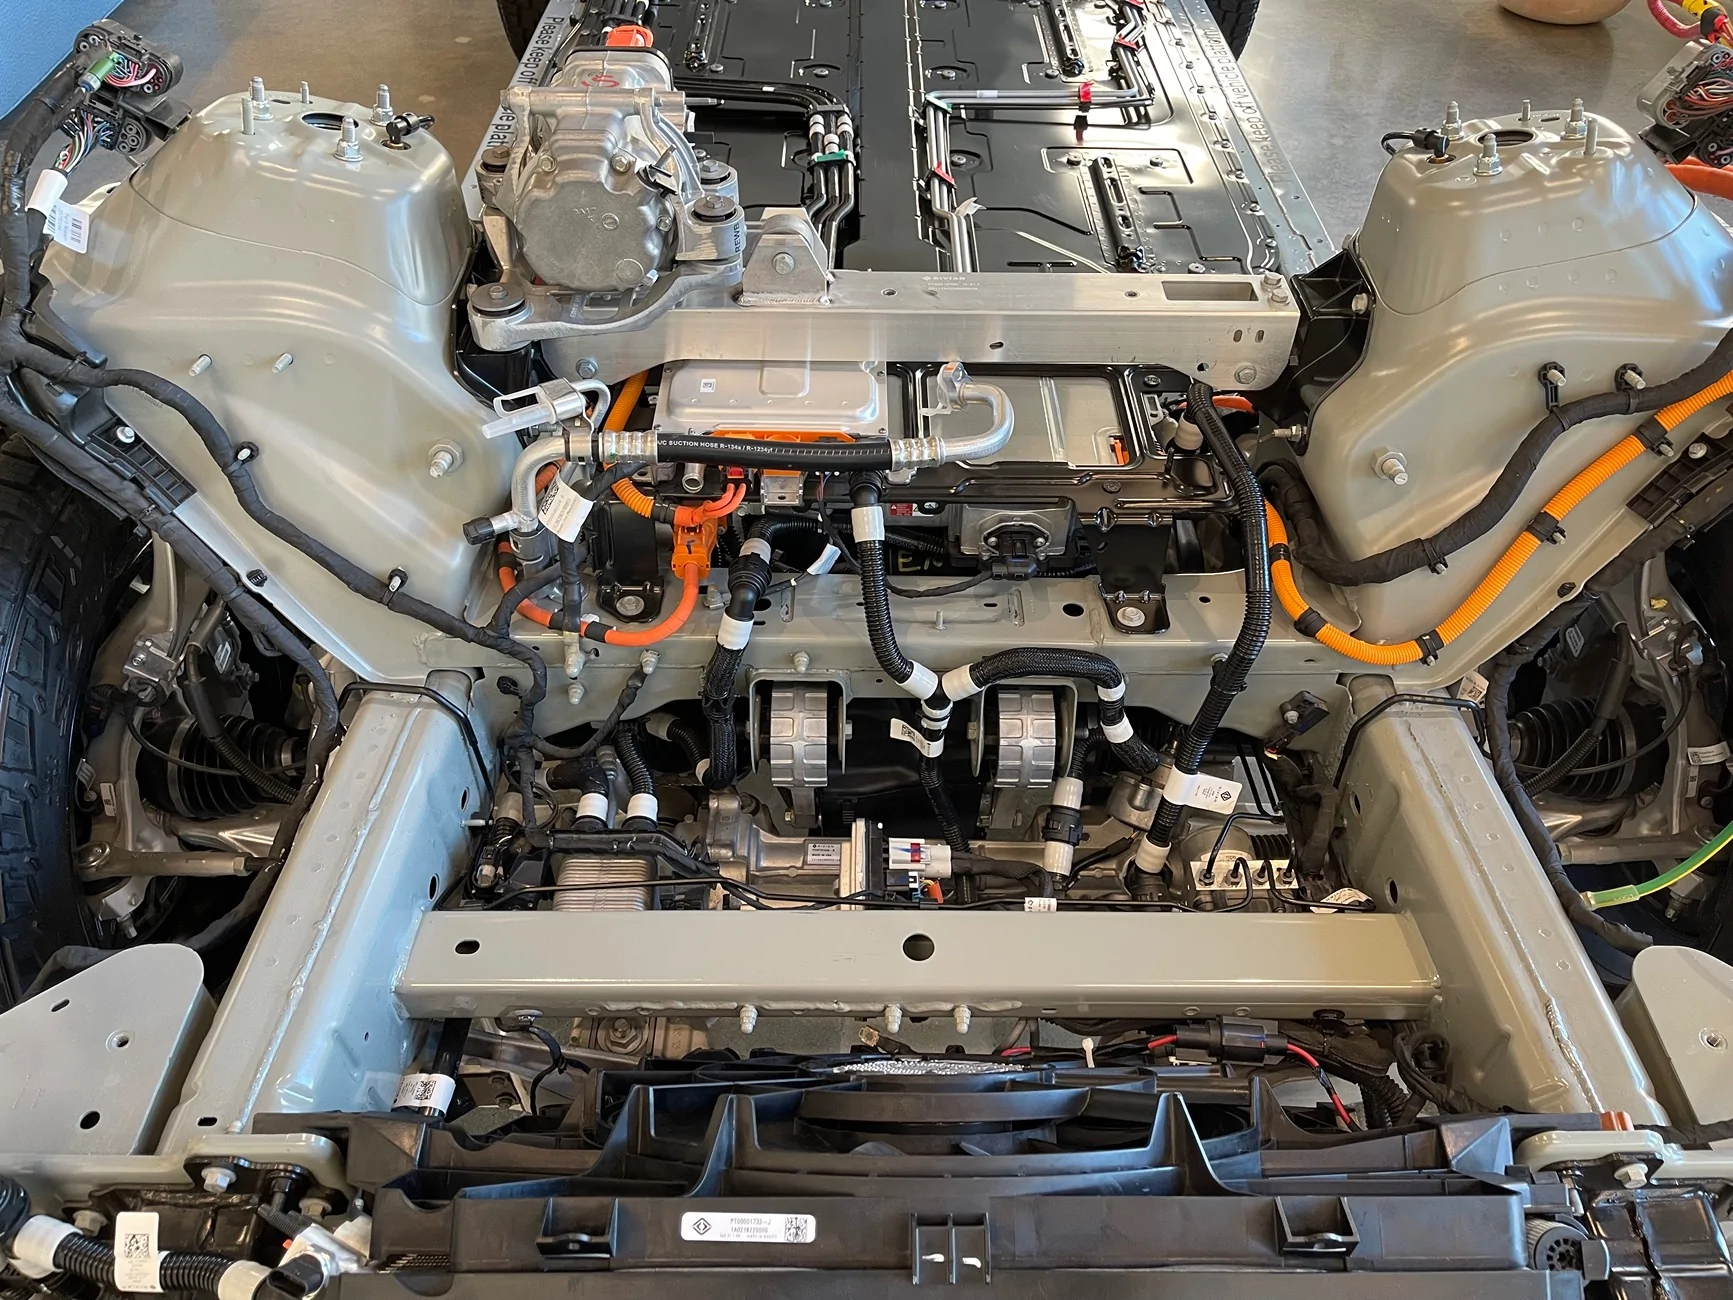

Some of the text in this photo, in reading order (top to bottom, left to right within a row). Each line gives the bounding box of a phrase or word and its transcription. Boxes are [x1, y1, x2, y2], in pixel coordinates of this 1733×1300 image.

[516, 16, 565, 86] Please keep off
[1203, 27, 1293, 182] Please keep off vehicle platform
[485, 123, 515, 148] plat
[700, 441, 718, 449] HOSE
[719, 443, 741, 451] R-134a
[746, 446, 773, 454] R-1234yf
